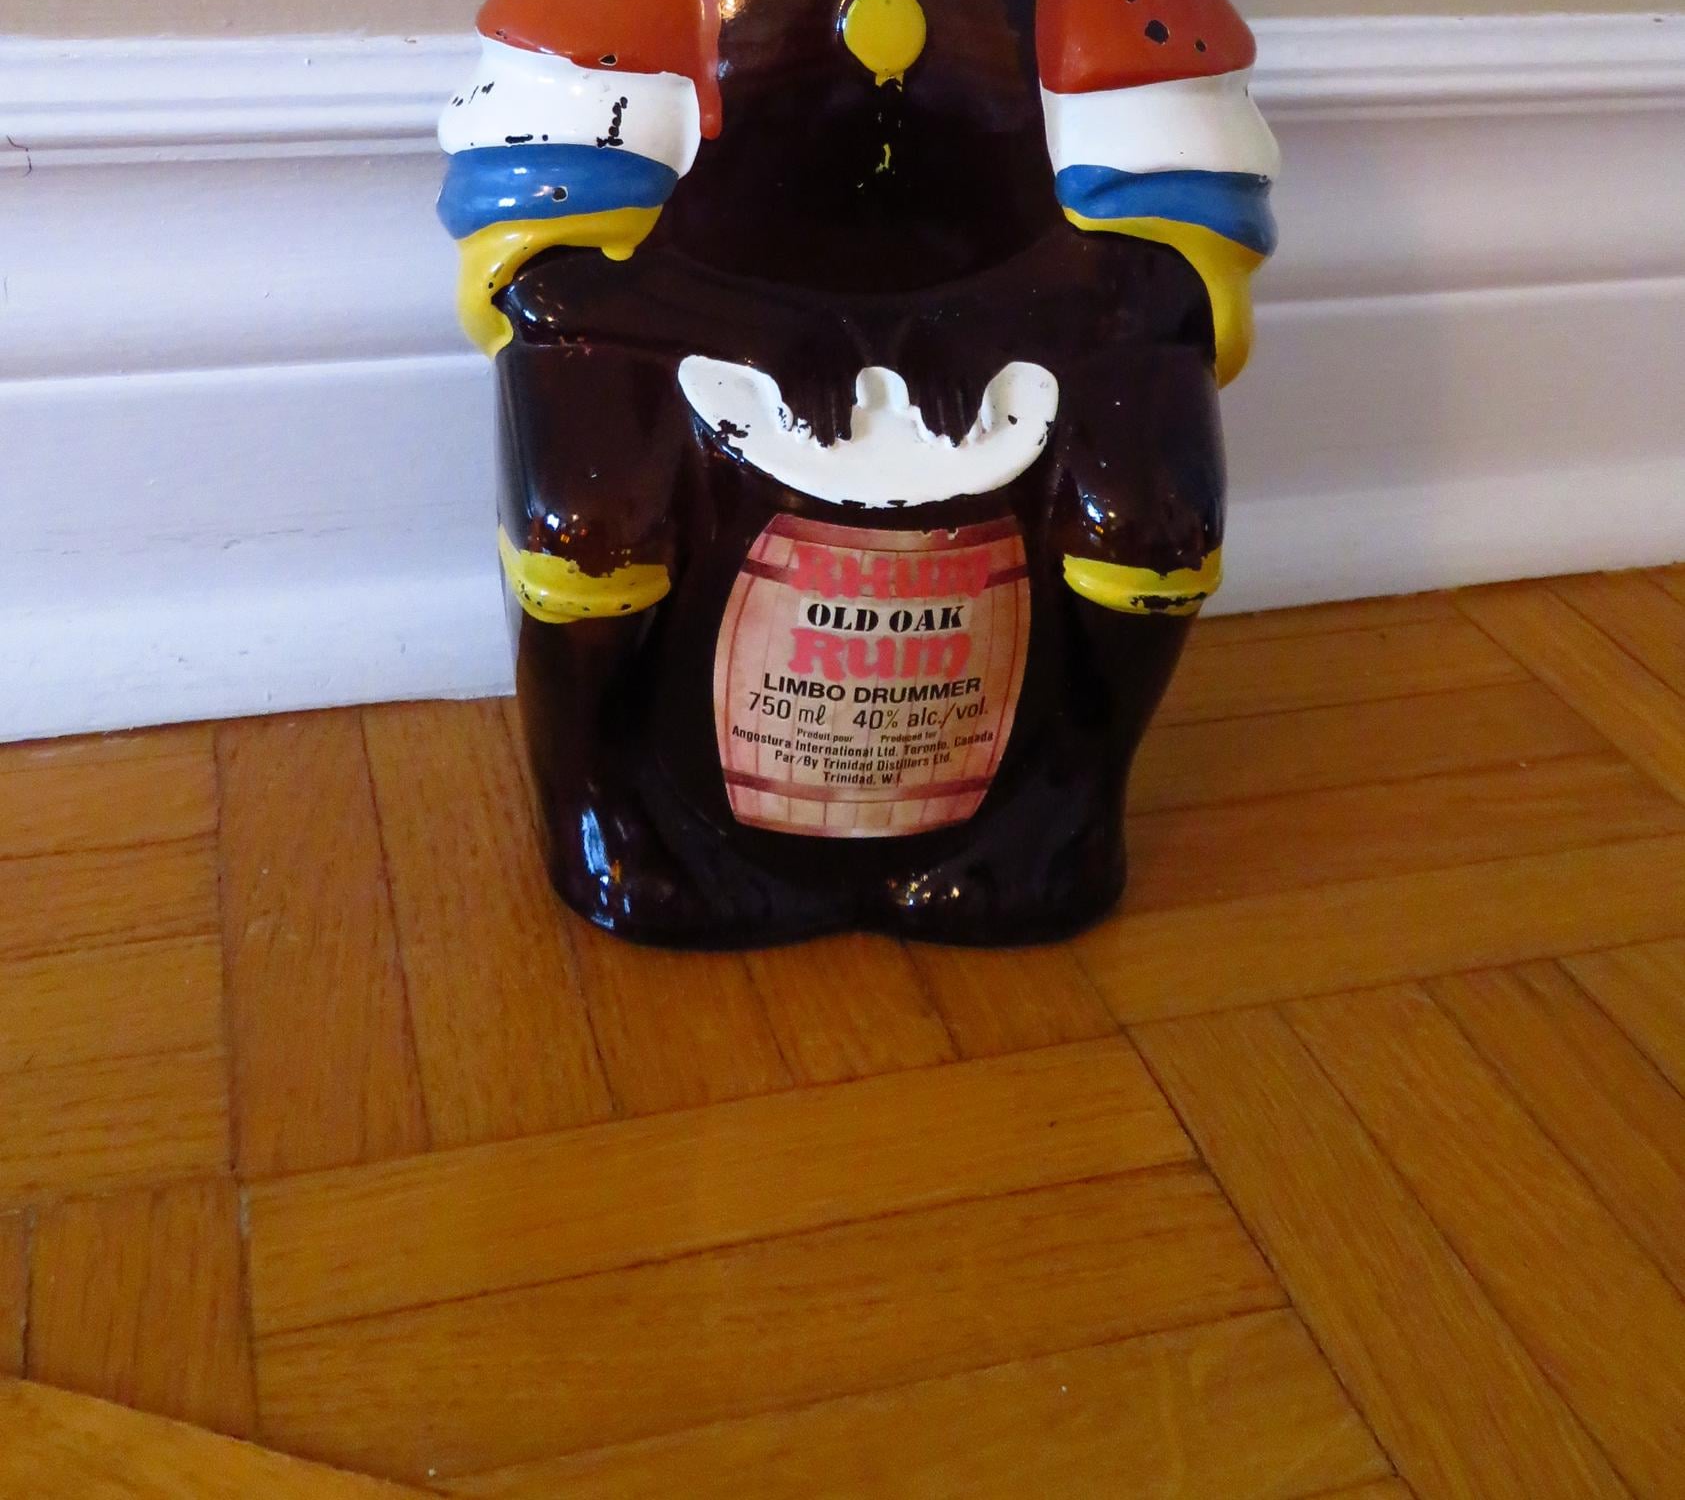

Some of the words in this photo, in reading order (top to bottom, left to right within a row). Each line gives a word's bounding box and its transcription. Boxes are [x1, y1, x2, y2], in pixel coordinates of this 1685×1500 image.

[806, 603, 879, 632] OLD
[889, 604, 964, 632] OAK
[763, 673, 846, 701] LIMBO
[853, 677, 982, 704] DRUMMER
[749, 691, 792, 720] 750
[852, 708, 900, 730] 40%
[732, 725, 792, 748] Angostura
[795, 740, 873, 758] International
[877, 746, 899, 757] Ltd.
[954, 731, 994, 748] Canada
[796, 728, 830, 741] Produit
[832, 734, 854, 743] pour
[880, 732, 922, 743] Produced
[775, 750, 819, 770] Par/By
[823, 757, 873, 771] Trinidad
[877, 757, 930, 771] Distillers
